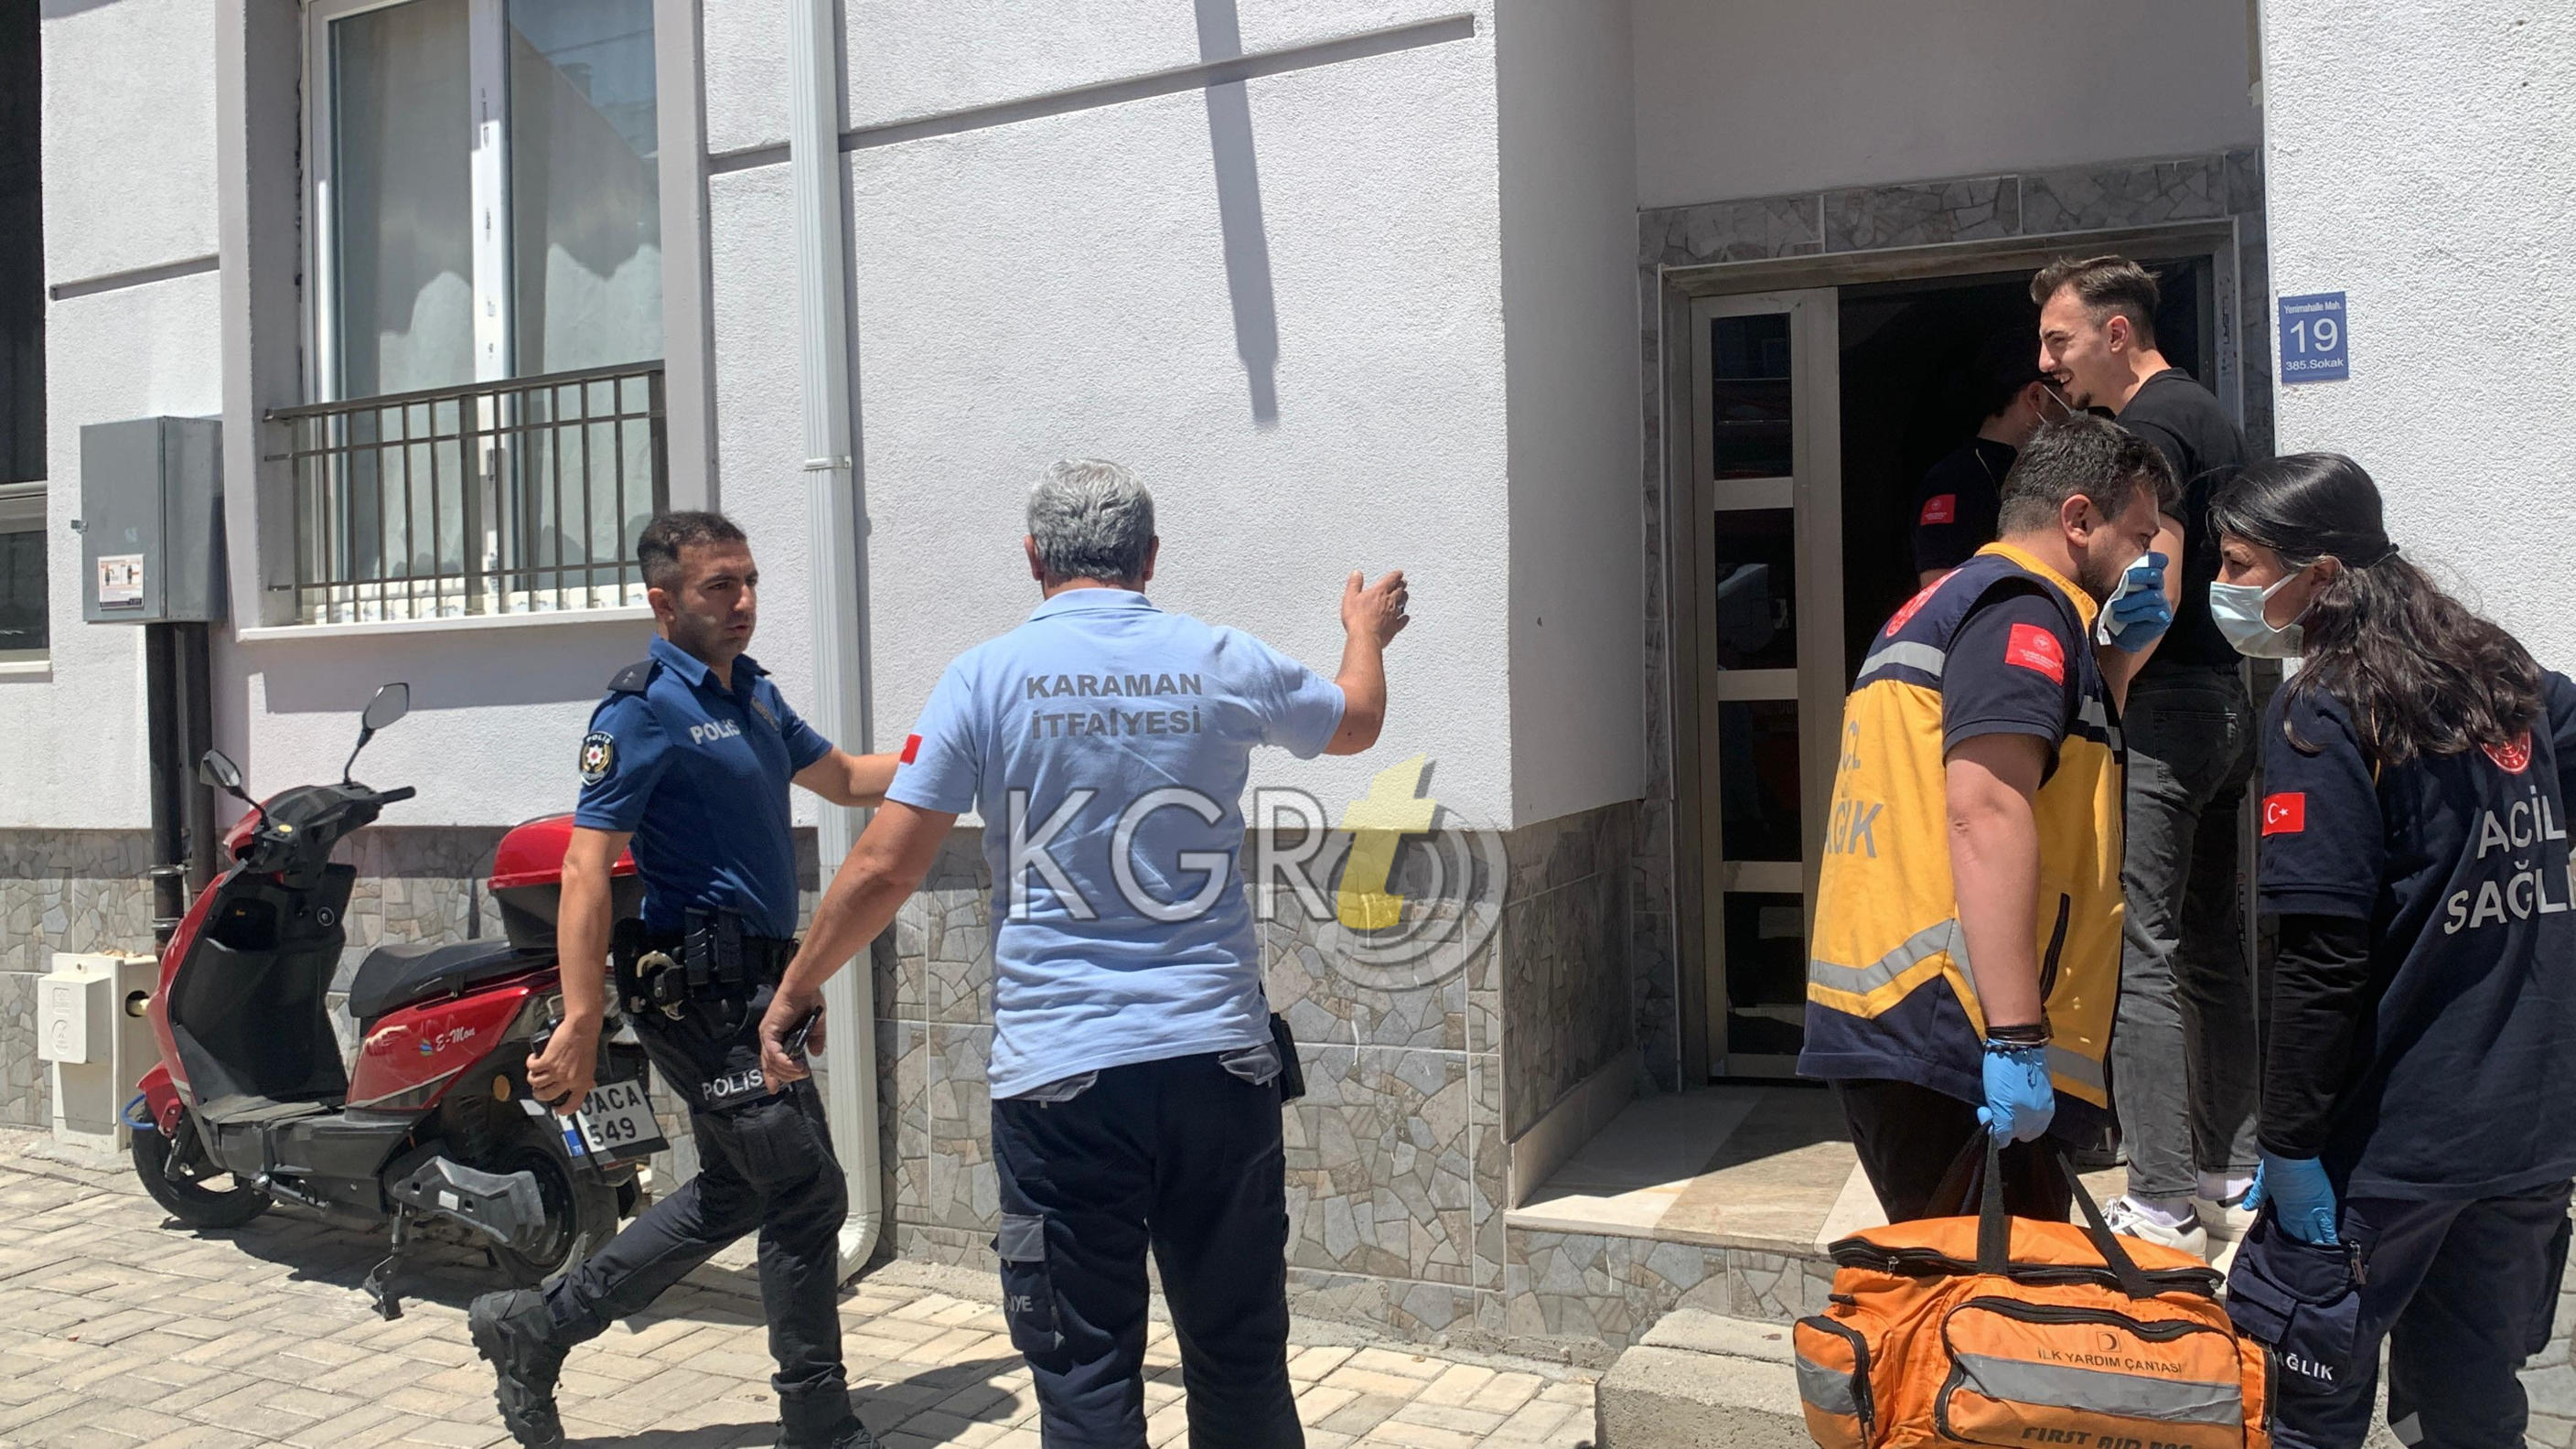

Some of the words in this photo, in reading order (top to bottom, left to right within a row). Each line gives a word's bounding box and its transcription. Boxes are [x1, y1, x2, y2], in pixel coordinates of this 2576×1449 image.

[2283, 302, 2324, 314] Yenimahalle
[2324, 300, 2342, 311] Mah.
[2290, 317, 2338, 353] 19
[2286, 358, 2344, 371] 385.Sokak
[1026, 673, 1203, 699] KARAMAN
[1032, 704, 1202, 739] İTFAİYESİ
[2477, 785, 2567, 859] ACİL
[587, 1116, 637, 1145] 549
[2037, 1347, 2062, 1361] İLK
[2065, 1352, 2120, 1368] YARDIM
[2124, 1358, 2182, 1373] ÇANTASI
[2022, 1426, 2091, 1445] FIRST
